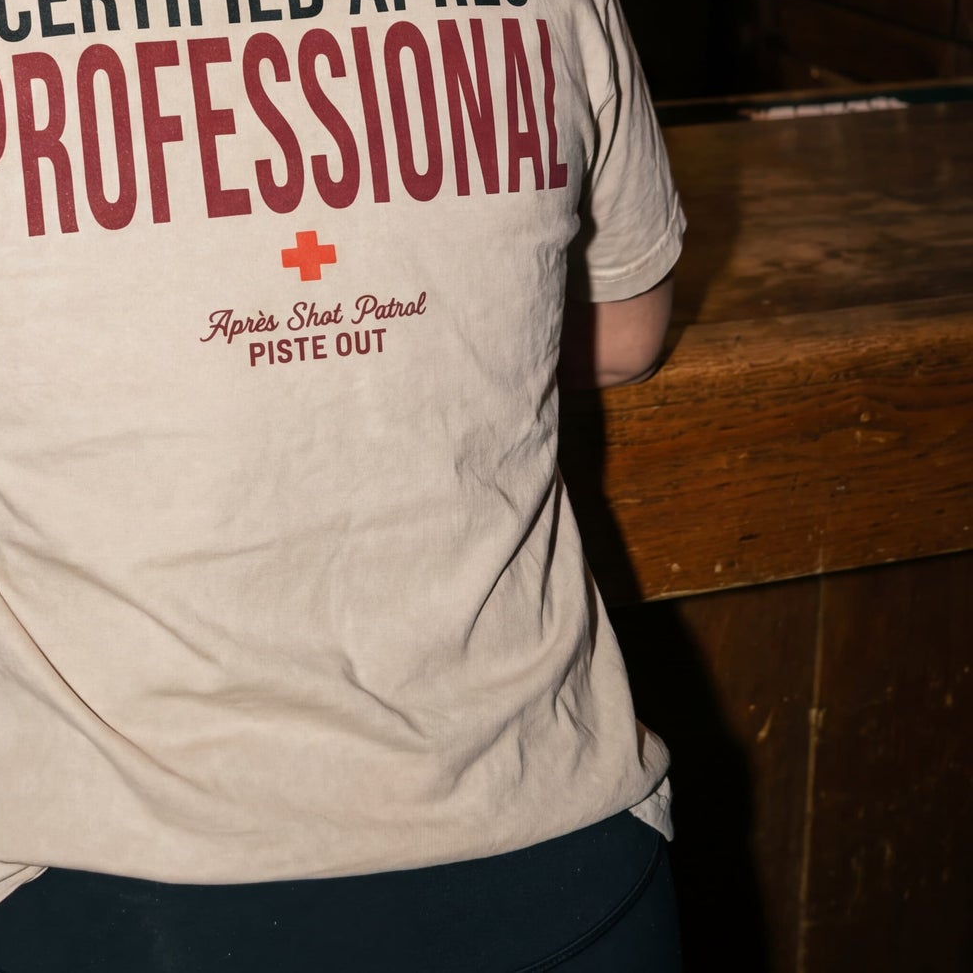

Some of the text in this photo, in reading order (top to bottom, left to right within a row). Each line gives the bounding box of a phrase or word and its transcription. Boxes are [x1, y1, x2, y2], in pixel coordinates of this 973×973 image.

[199, 291, 426, 344] Après Shot Patrol
[249, 328, 386, 366] PISTE OUT
